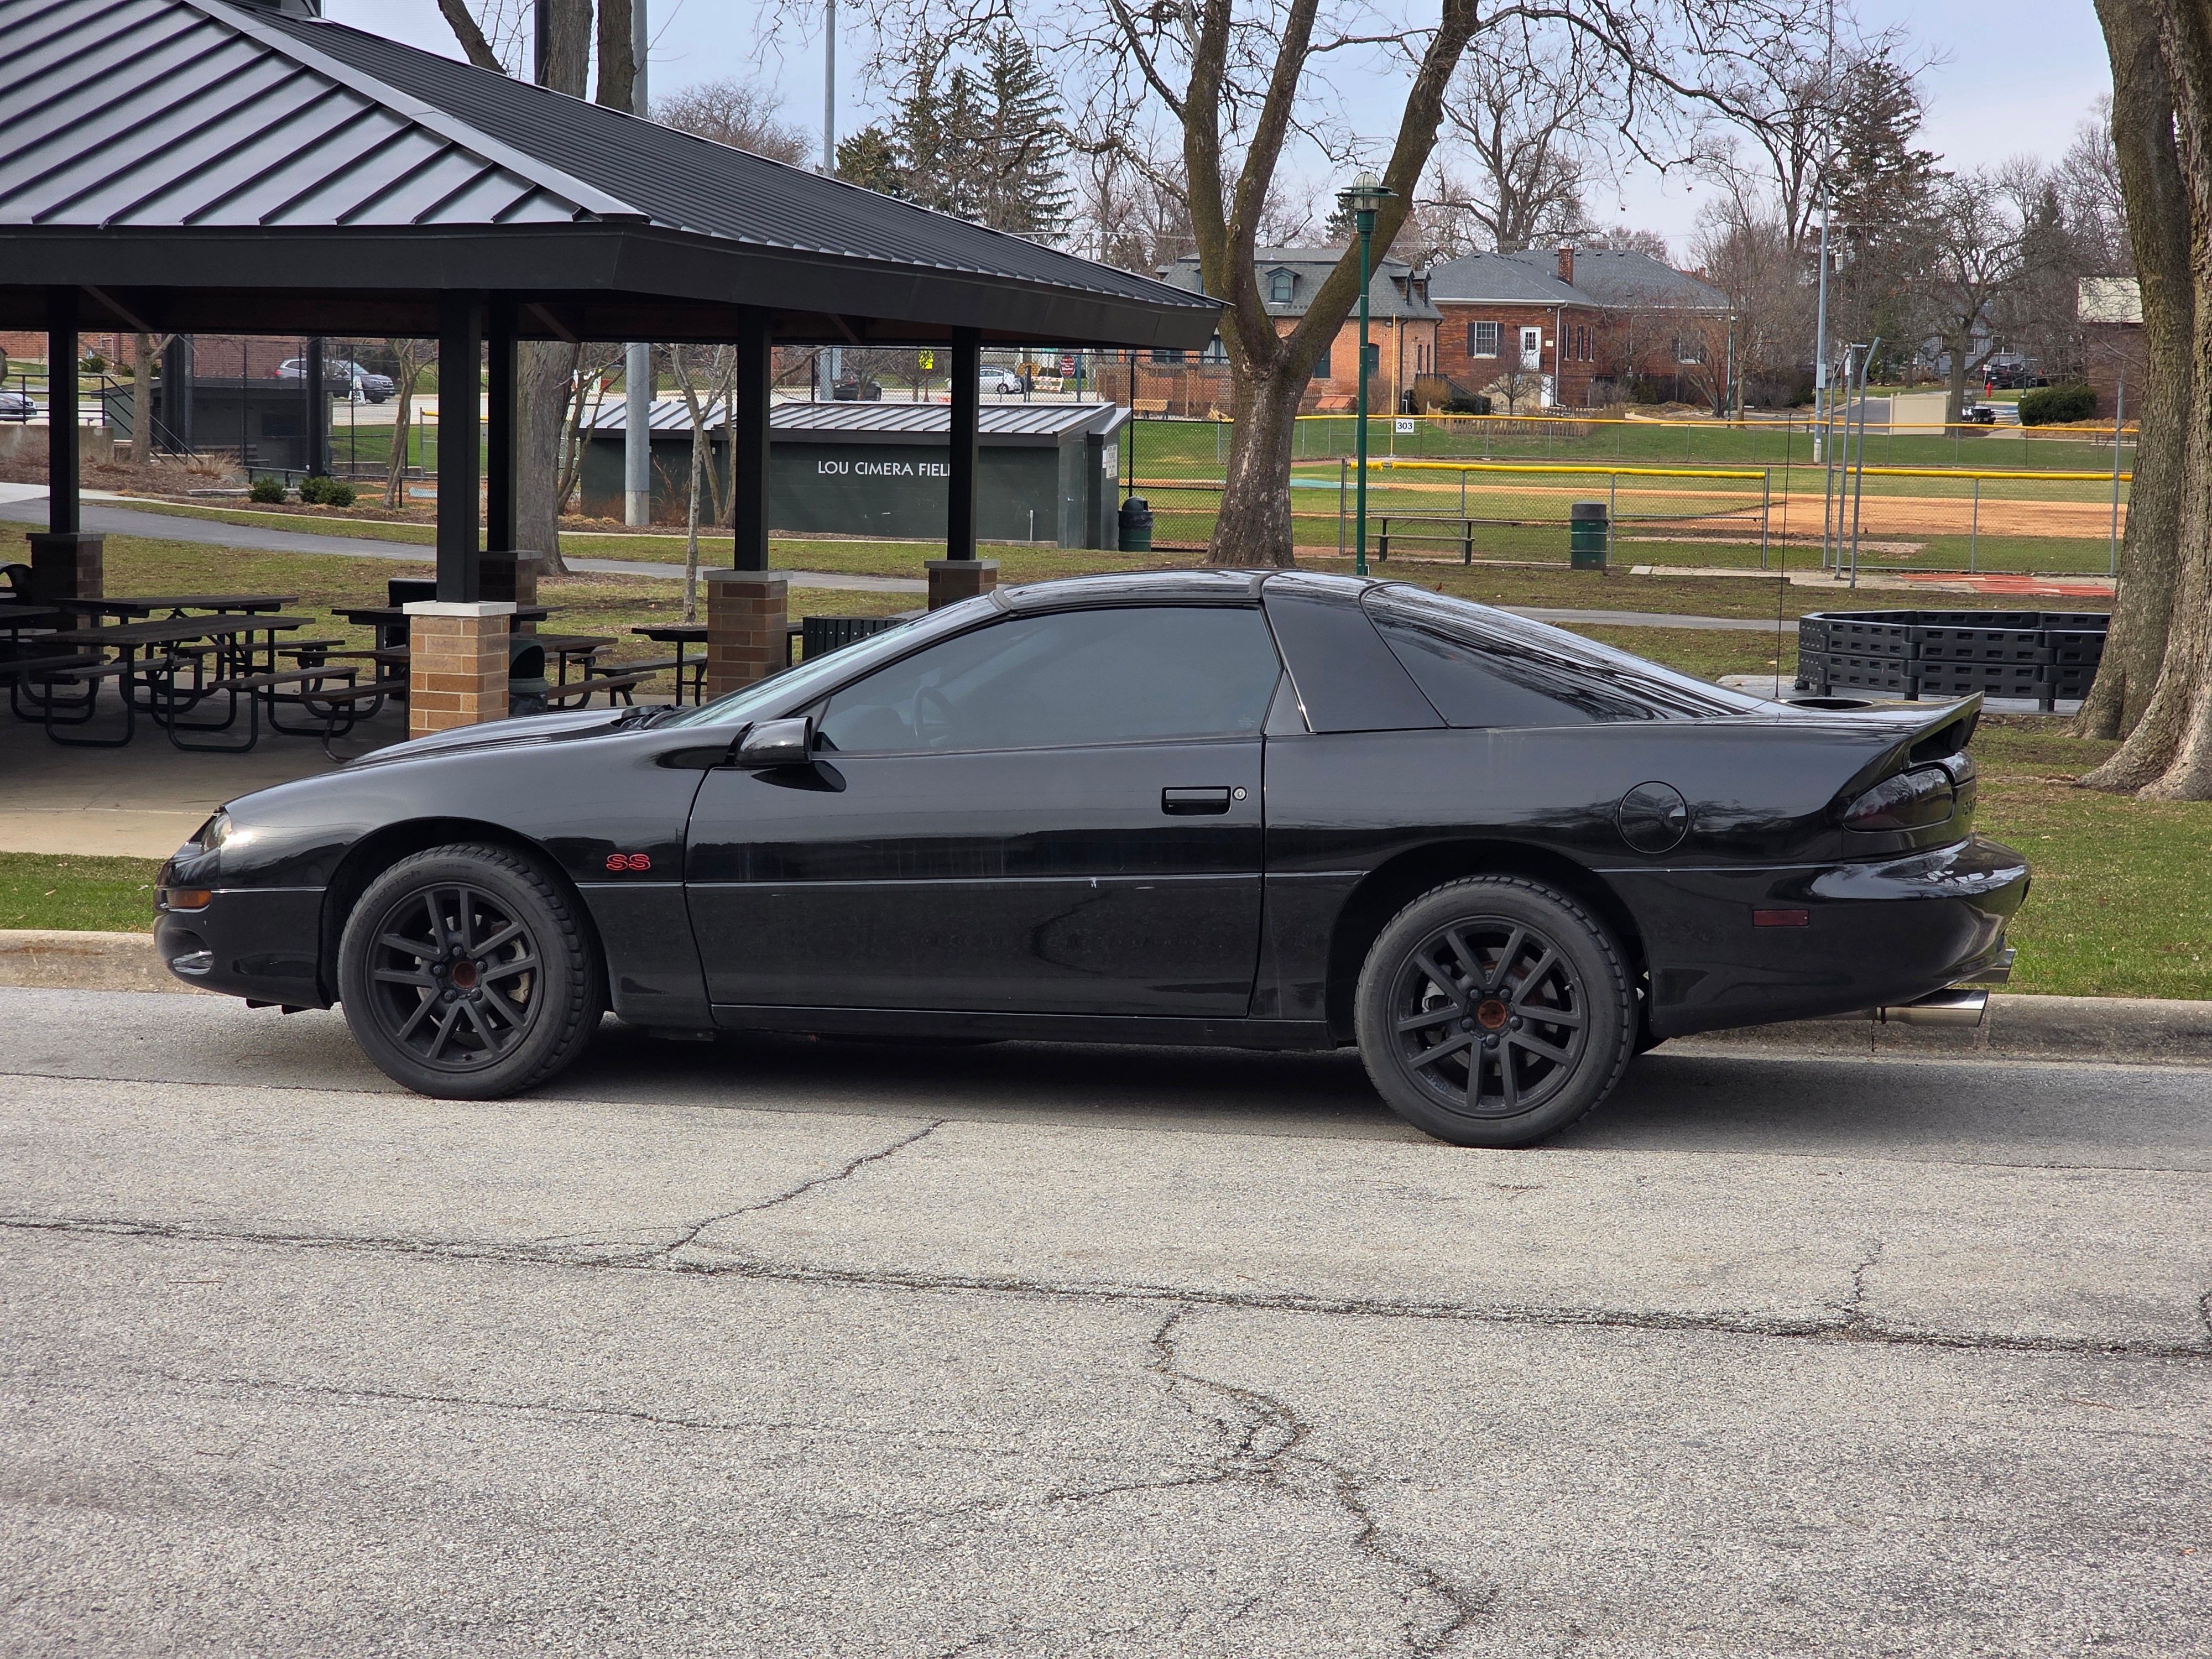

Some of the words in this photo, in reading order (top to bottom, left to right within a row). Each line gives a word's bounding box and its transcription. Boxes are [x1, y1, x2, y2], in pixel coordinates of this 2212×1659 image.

[818, 461, 849, 474] LOU
[855, 462, 914, 476] CIMERA
[919, 463, 950, 476] FIEL
[606, 854, 651, 870] SS
